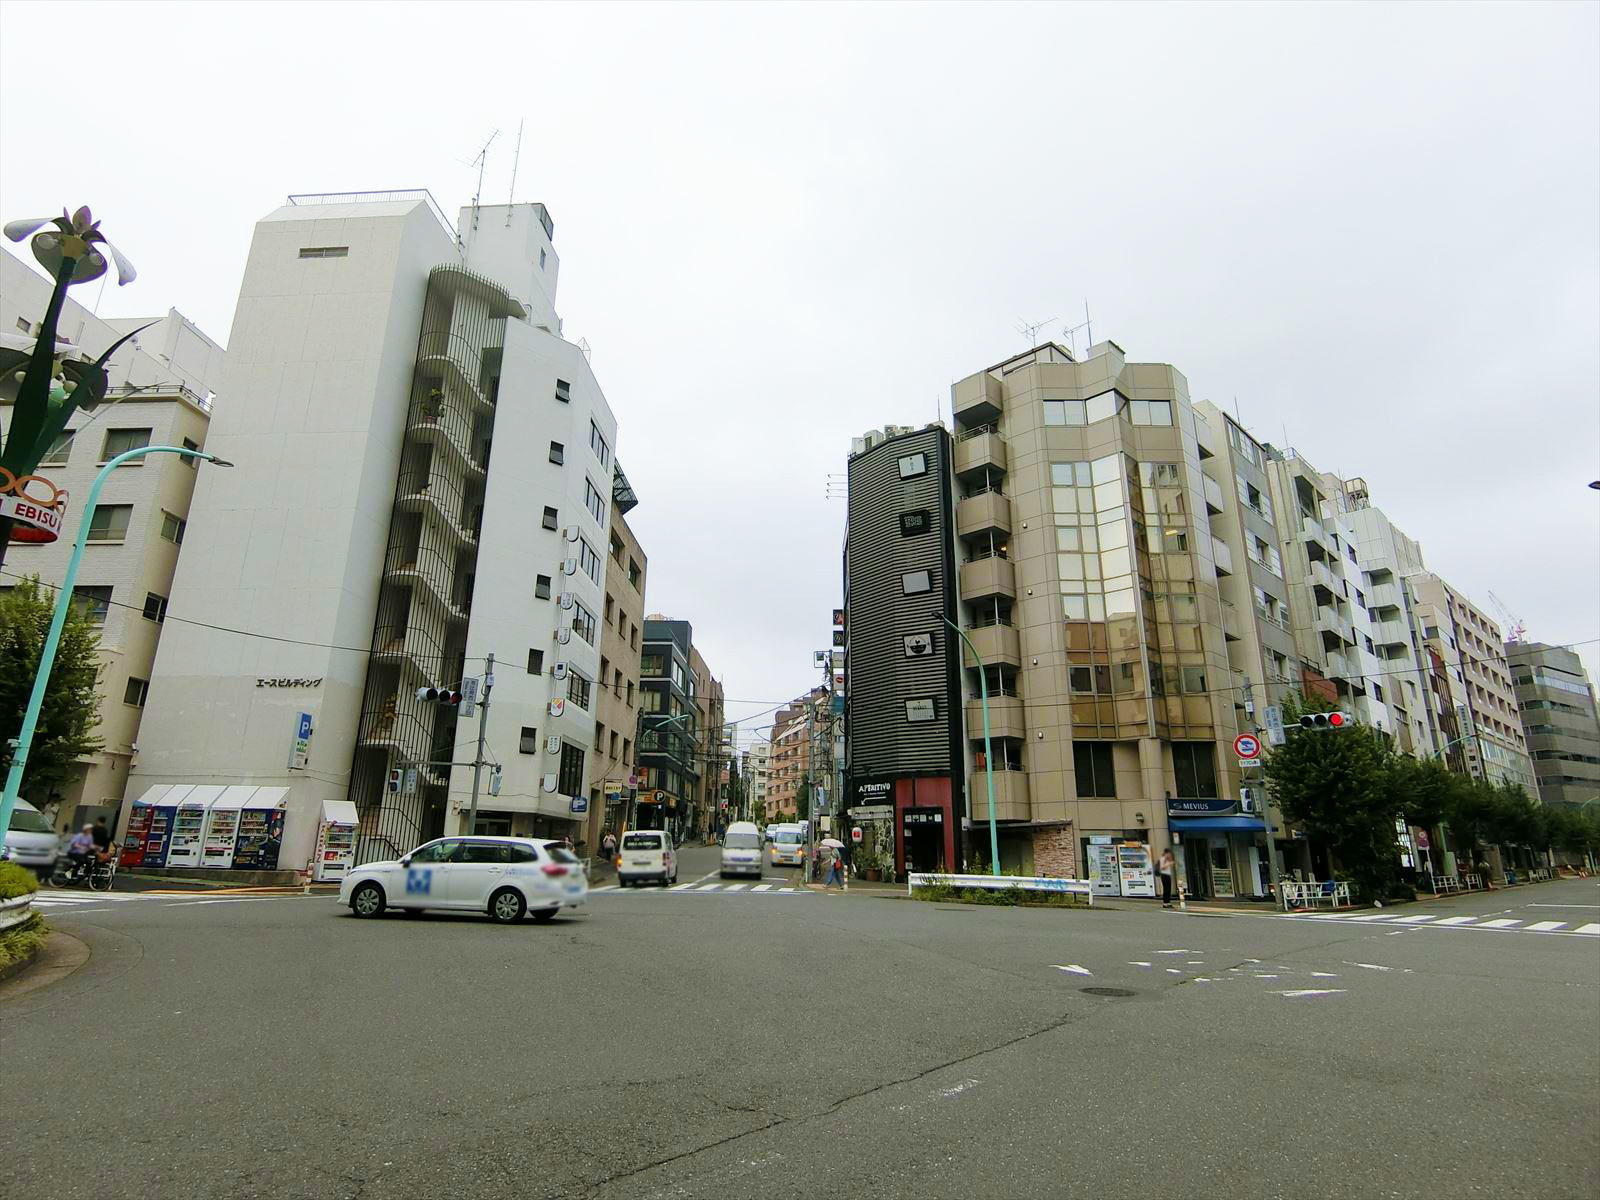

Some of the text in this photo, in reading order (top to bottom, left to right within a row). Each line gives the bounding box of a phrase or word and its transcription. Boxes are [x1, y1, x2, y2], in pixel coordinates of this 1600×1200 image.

[15, 502, 58, 528] EBISU
[255, 677, 323, 688] エースビルディング
[301, 721, 310, 734] P
[657, 792, 664, 800] P
